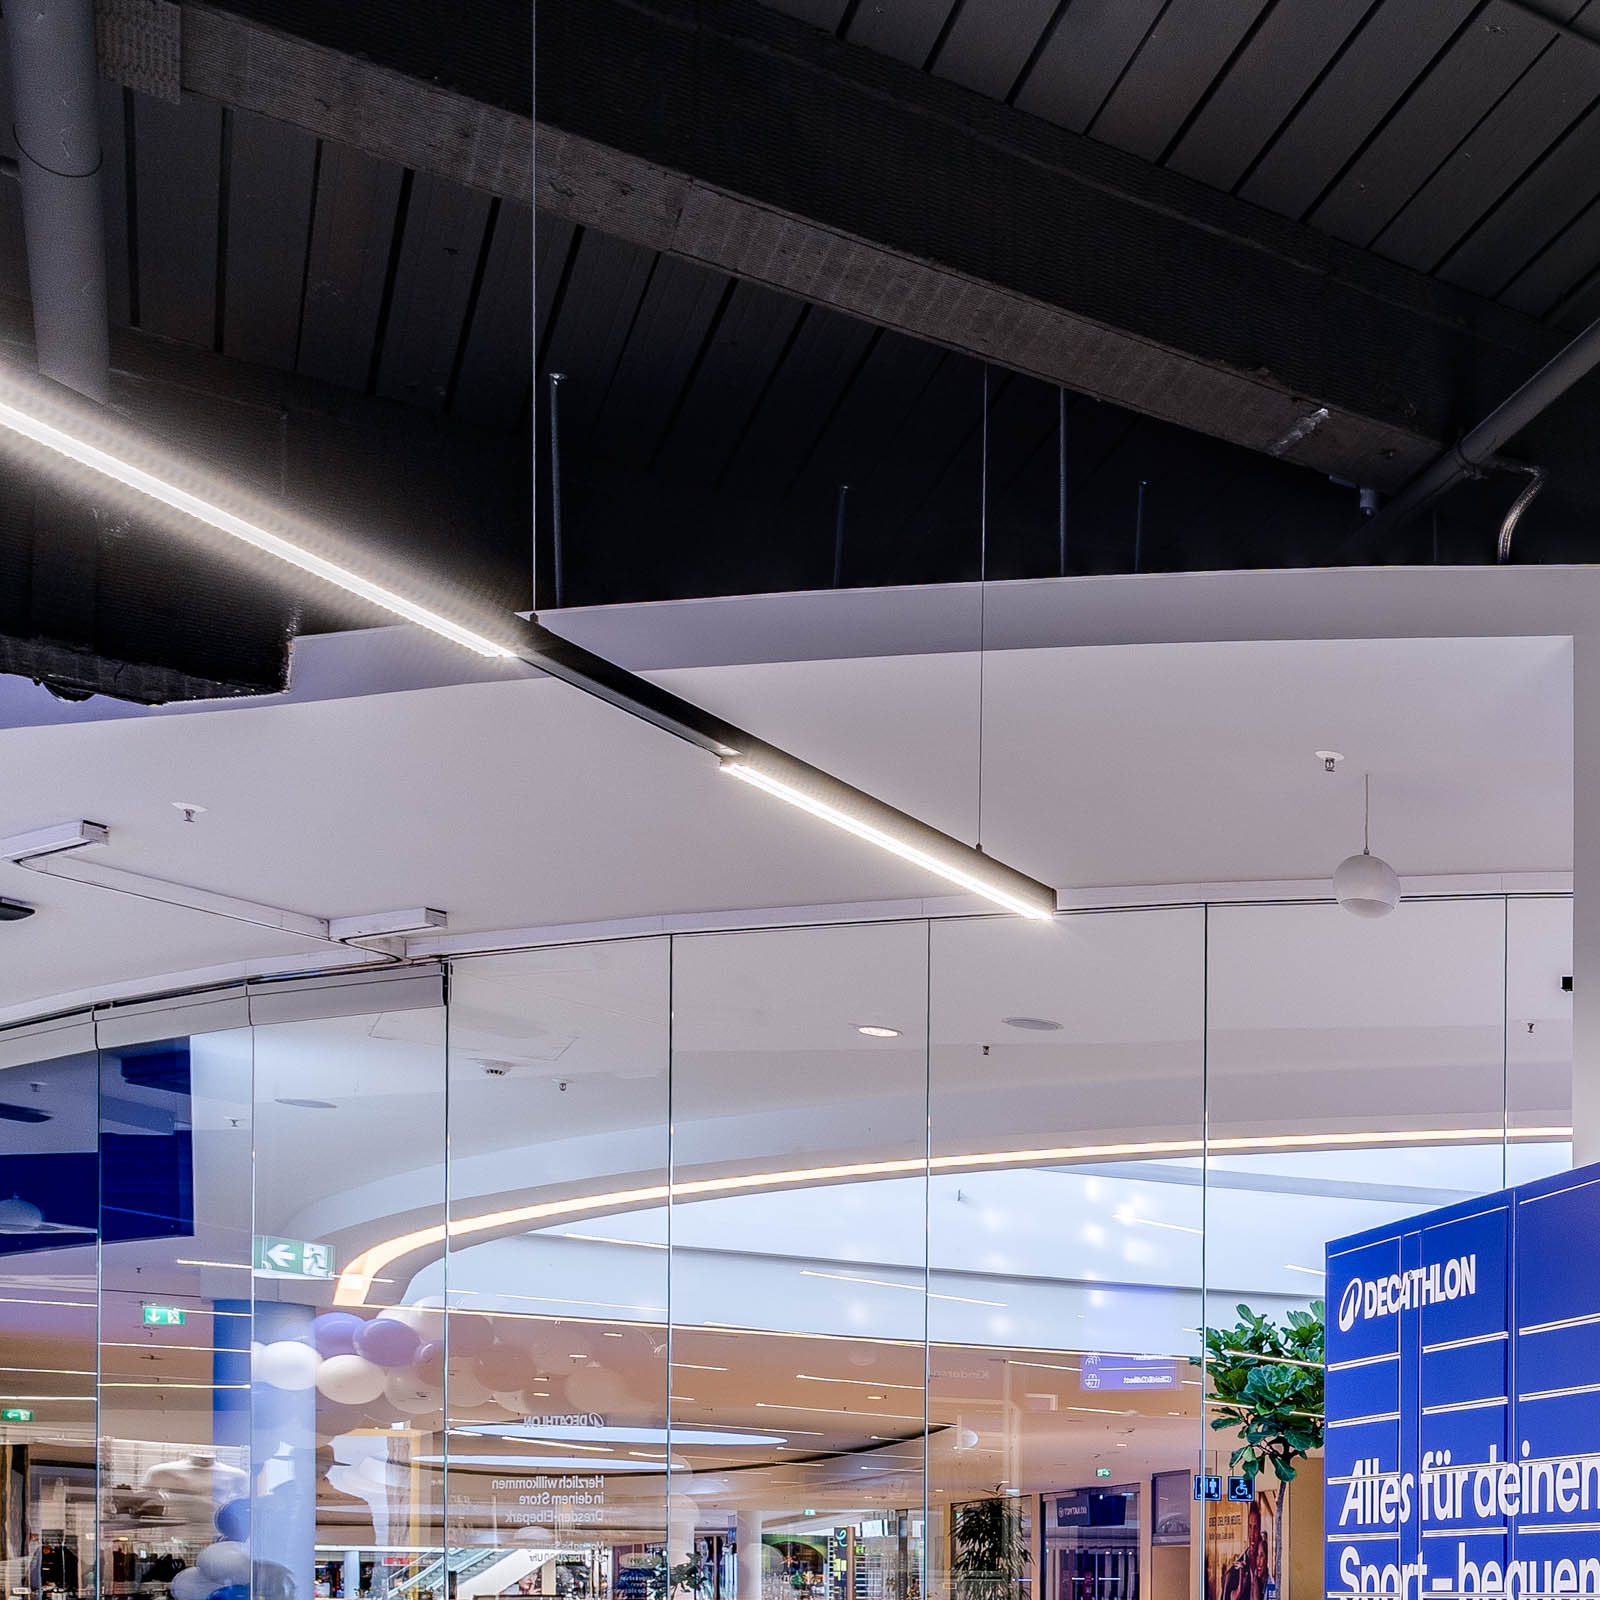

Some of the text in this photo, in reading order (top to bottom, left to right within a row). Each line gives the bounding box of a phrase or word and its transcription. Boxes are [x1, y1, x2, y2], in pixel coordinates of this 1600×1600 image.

[1364, 1254, 1476, 1320] DECATHLON
[1339, 1457, 1414, 1526] Alles
[1420, 1449, 1468, 1521] für
